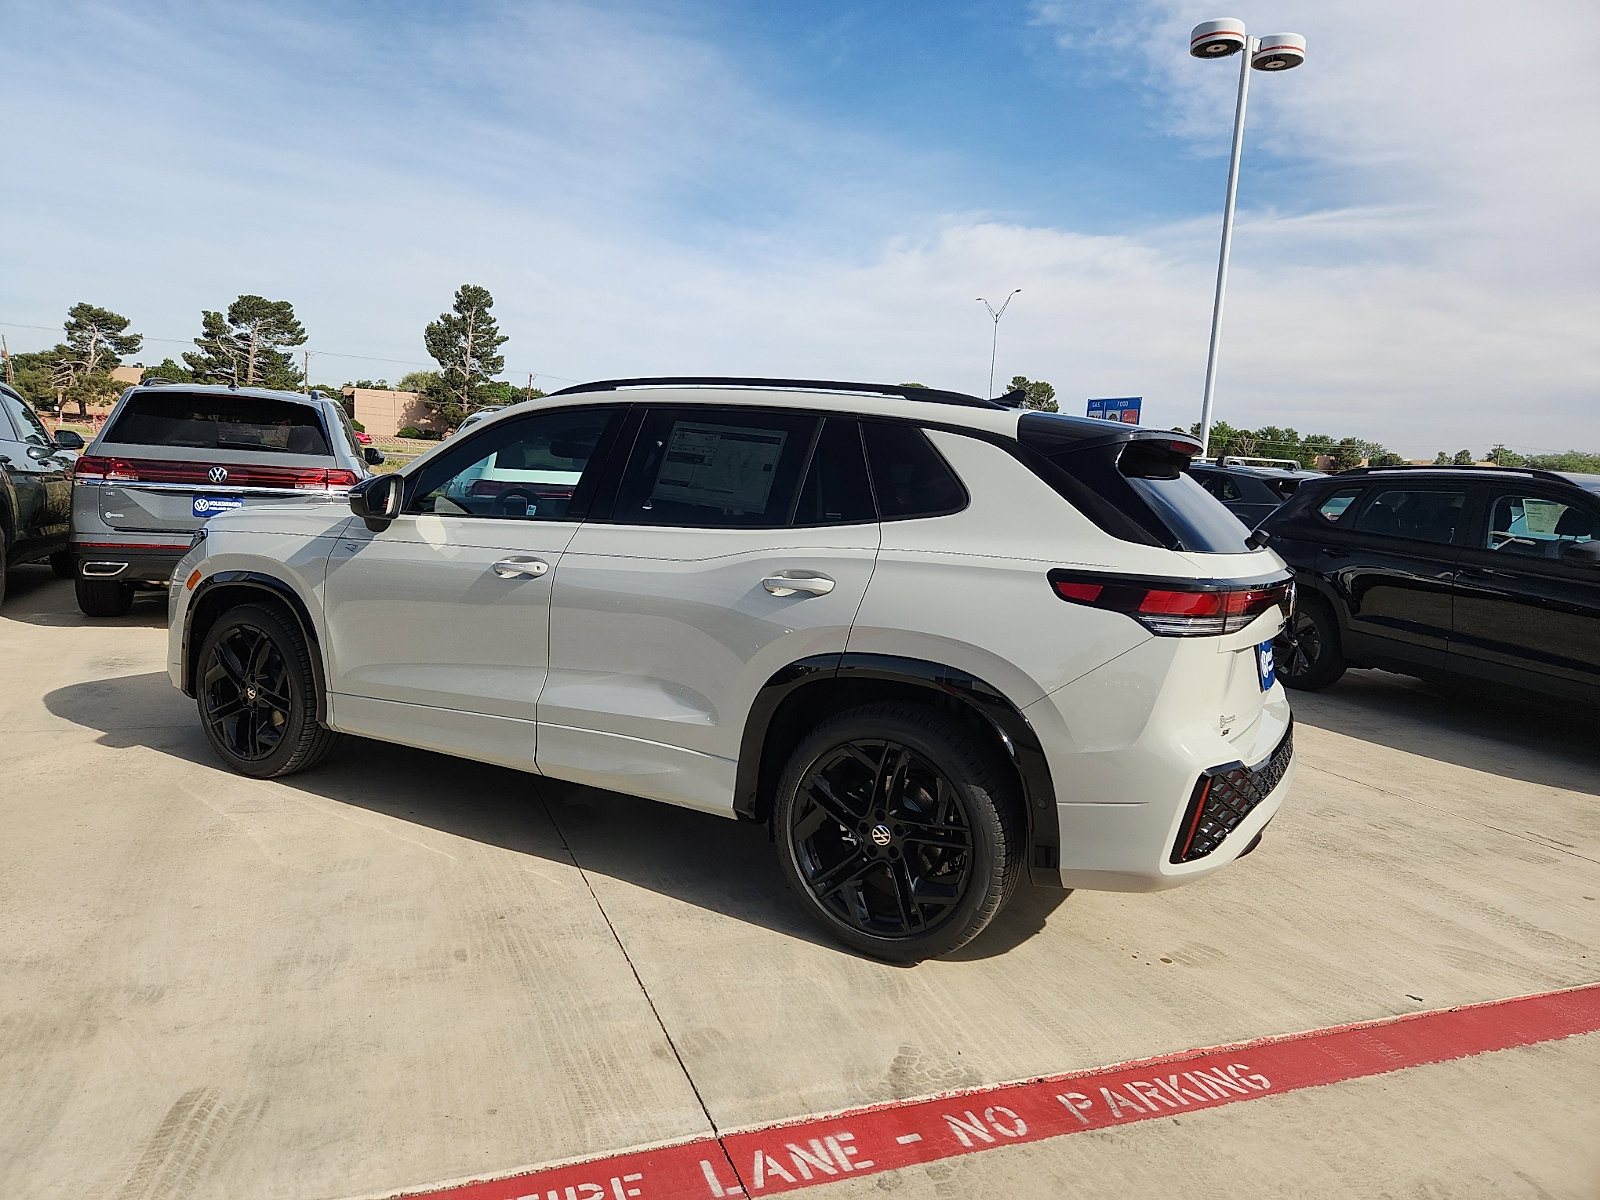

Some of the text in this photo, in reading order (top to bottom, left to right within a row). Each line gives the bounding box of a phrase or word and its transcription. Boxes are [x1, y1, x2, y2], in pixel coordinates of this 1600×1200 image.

[700, 1132, 875, 1198] LANE
[943, 1106, 1028, 1148] NO
[1055, 1063, 1271, 1125] PARKING
